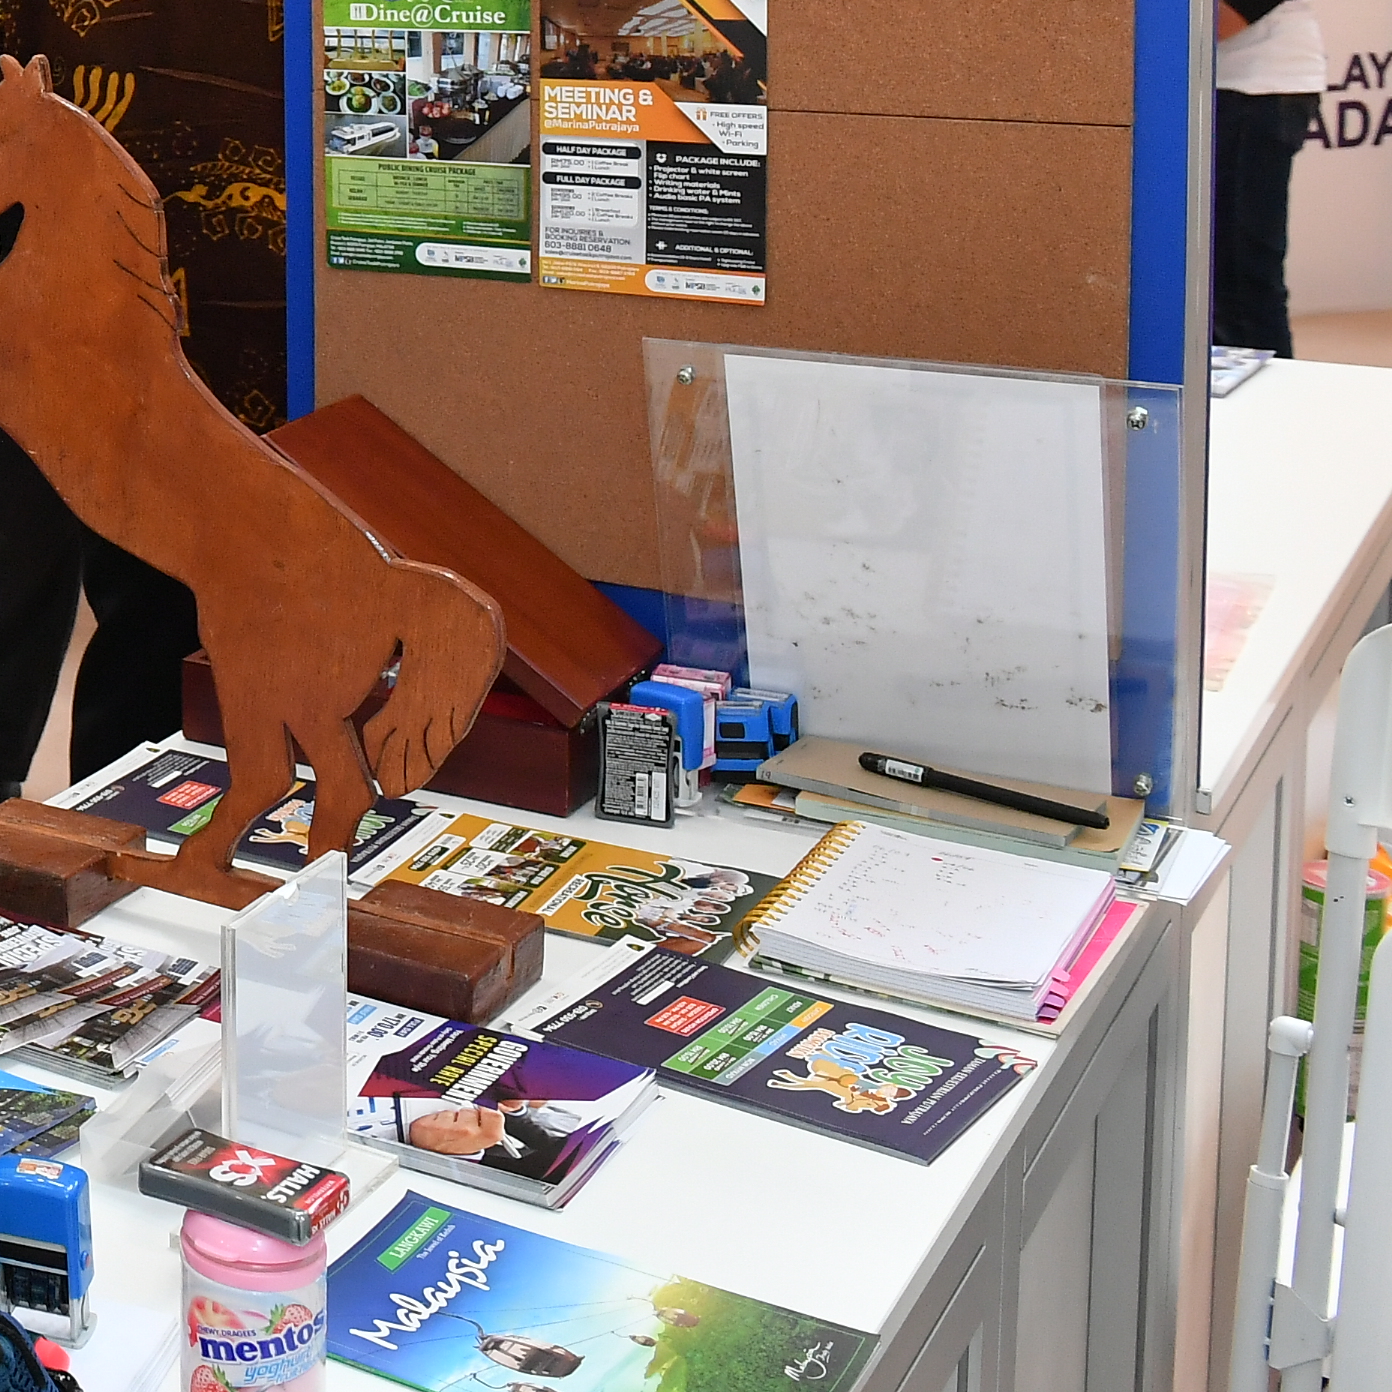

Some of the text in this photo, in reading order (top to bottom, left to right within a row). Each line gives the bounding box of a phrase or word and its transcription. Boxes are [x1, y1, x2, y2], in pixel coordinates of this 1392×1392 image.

[544, 86, 653, 105] MEETING &
[544, 103, 636, 121] SEMINAR
[710, 111, 730, 119] FREE
[544, 119, 639, 133] @MarinaPutrajaya
[716, 121, 736, 129] High
[719, 130, 743, 138] Wi-Fi
[447, 166, 476, 176] PACKAGE
[653, 165, 689, 174] Projector
[452, 1034, 498, 1071] SPECIAL
[429, 1064, 465, 1087] RATE
[440, 1039, 529, 1105] GOVERNMENT
[209, 1150, 276, 1187] XS
[266, 1163, 322, 1204] HALLS
[389, 1216, 439, 1258] LANGKAWI
[349, 1237, 506, 1351] Malaysia
[197, 1325, 257, 1337] CHEWY DRAGEES
[200, 1309, 324, 1363] mentos
